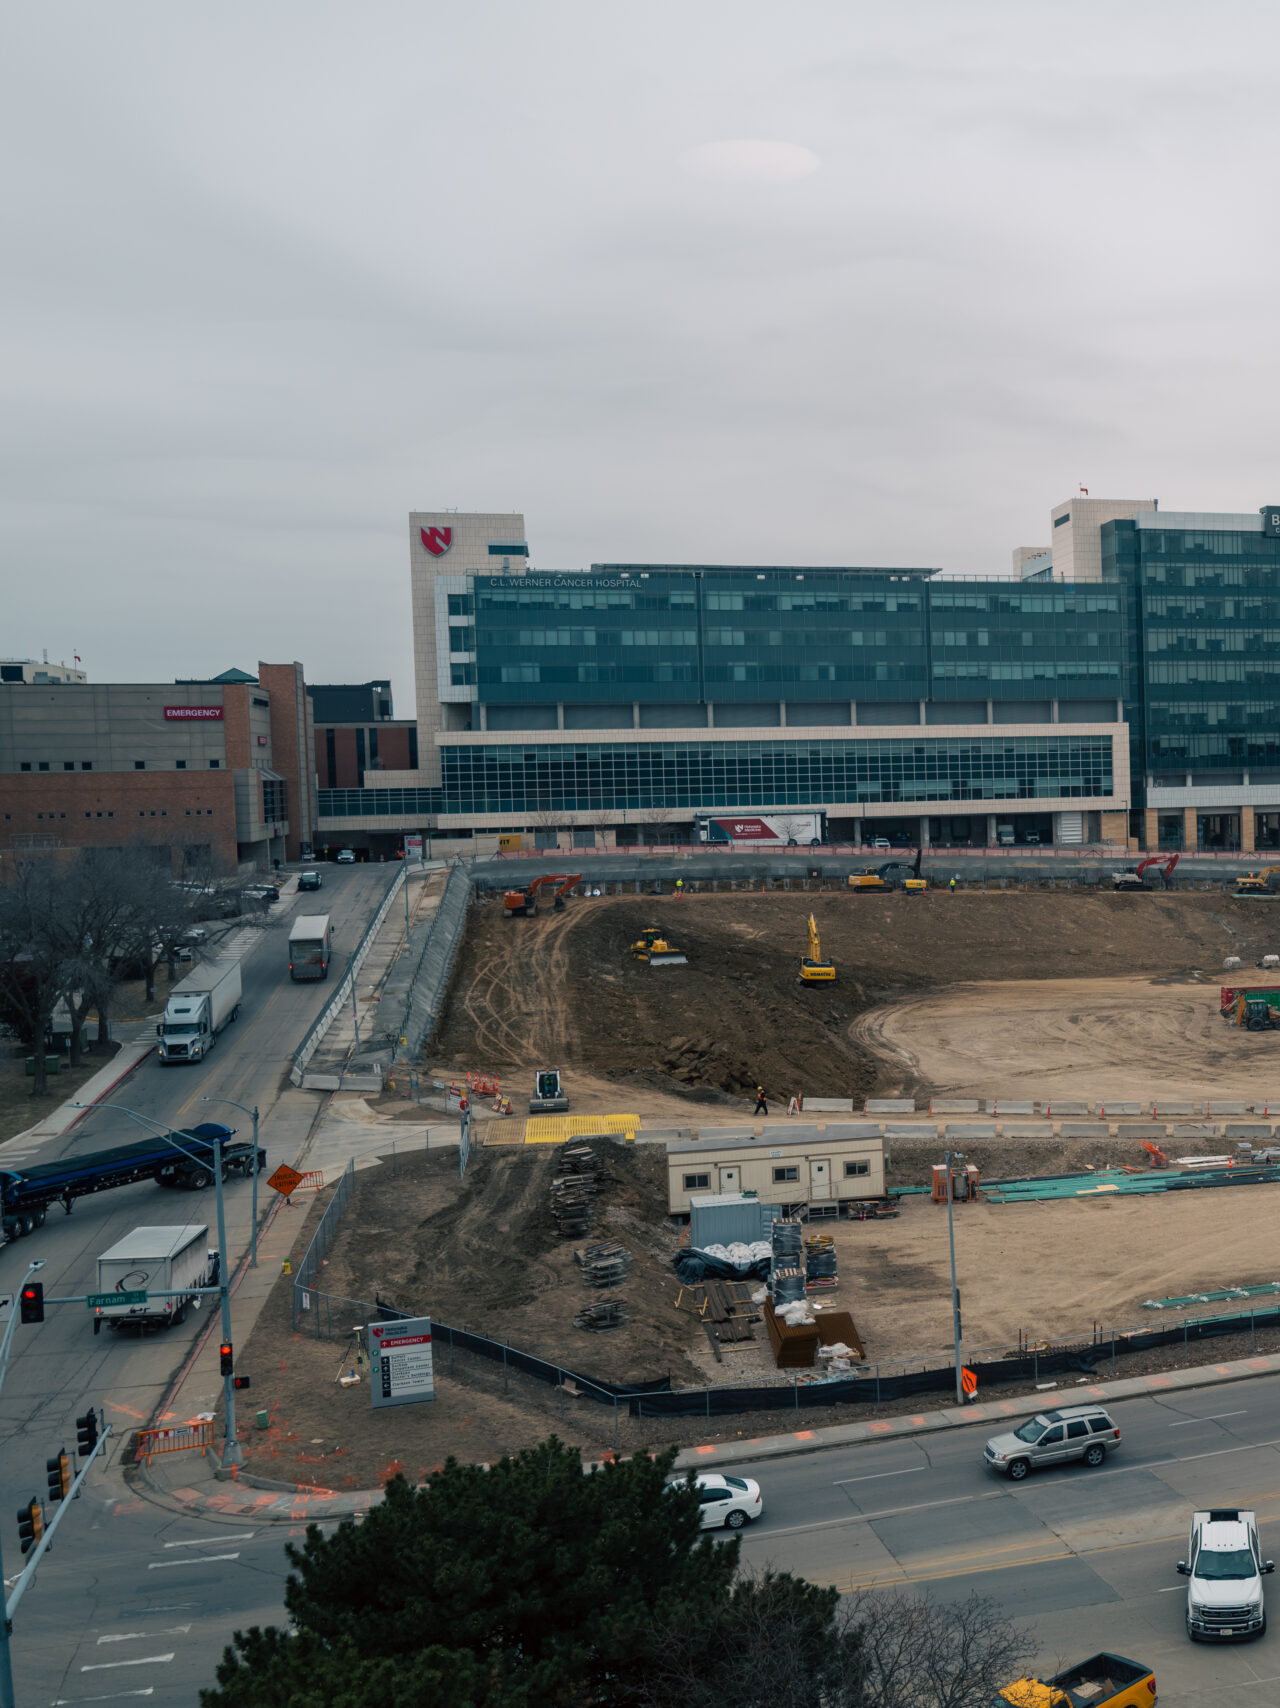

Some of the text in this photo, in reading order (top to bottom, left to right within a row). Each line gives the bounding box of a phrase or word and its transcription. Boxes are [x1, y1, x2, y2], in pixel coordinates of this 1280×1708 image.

[490, 578, 641, 588] C.L. WERNER CANCER HOSPITAL
[166, 709, 221, 717] EMERGENCY
[89, 1296, 126, 1306] Farnam
[390, 1337, 424, 1346] EMERGENCY
